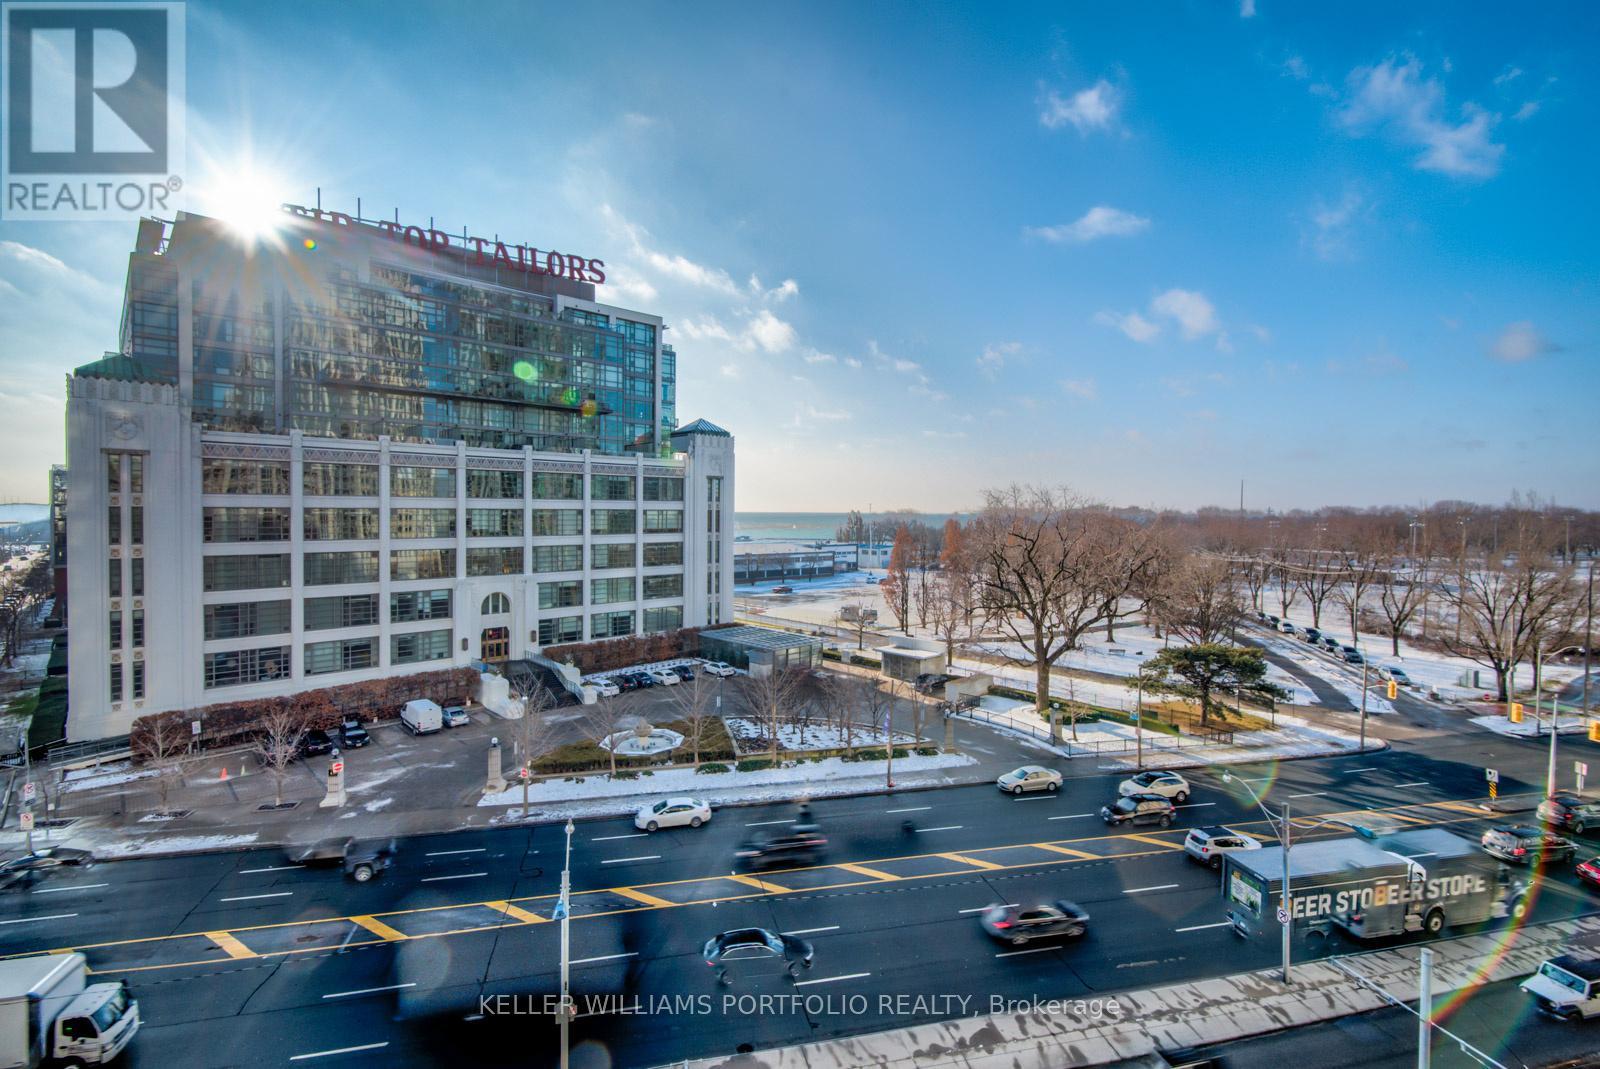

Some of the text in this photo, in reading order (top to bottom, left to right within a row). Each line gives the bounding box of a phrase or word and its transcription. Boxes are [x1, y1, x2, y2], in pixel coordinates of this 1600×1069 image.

[379, 219, 449, 256] TOP
[469, 236, 606, 285] TAILORS
[1426, 874, 1486, 899] STORE
